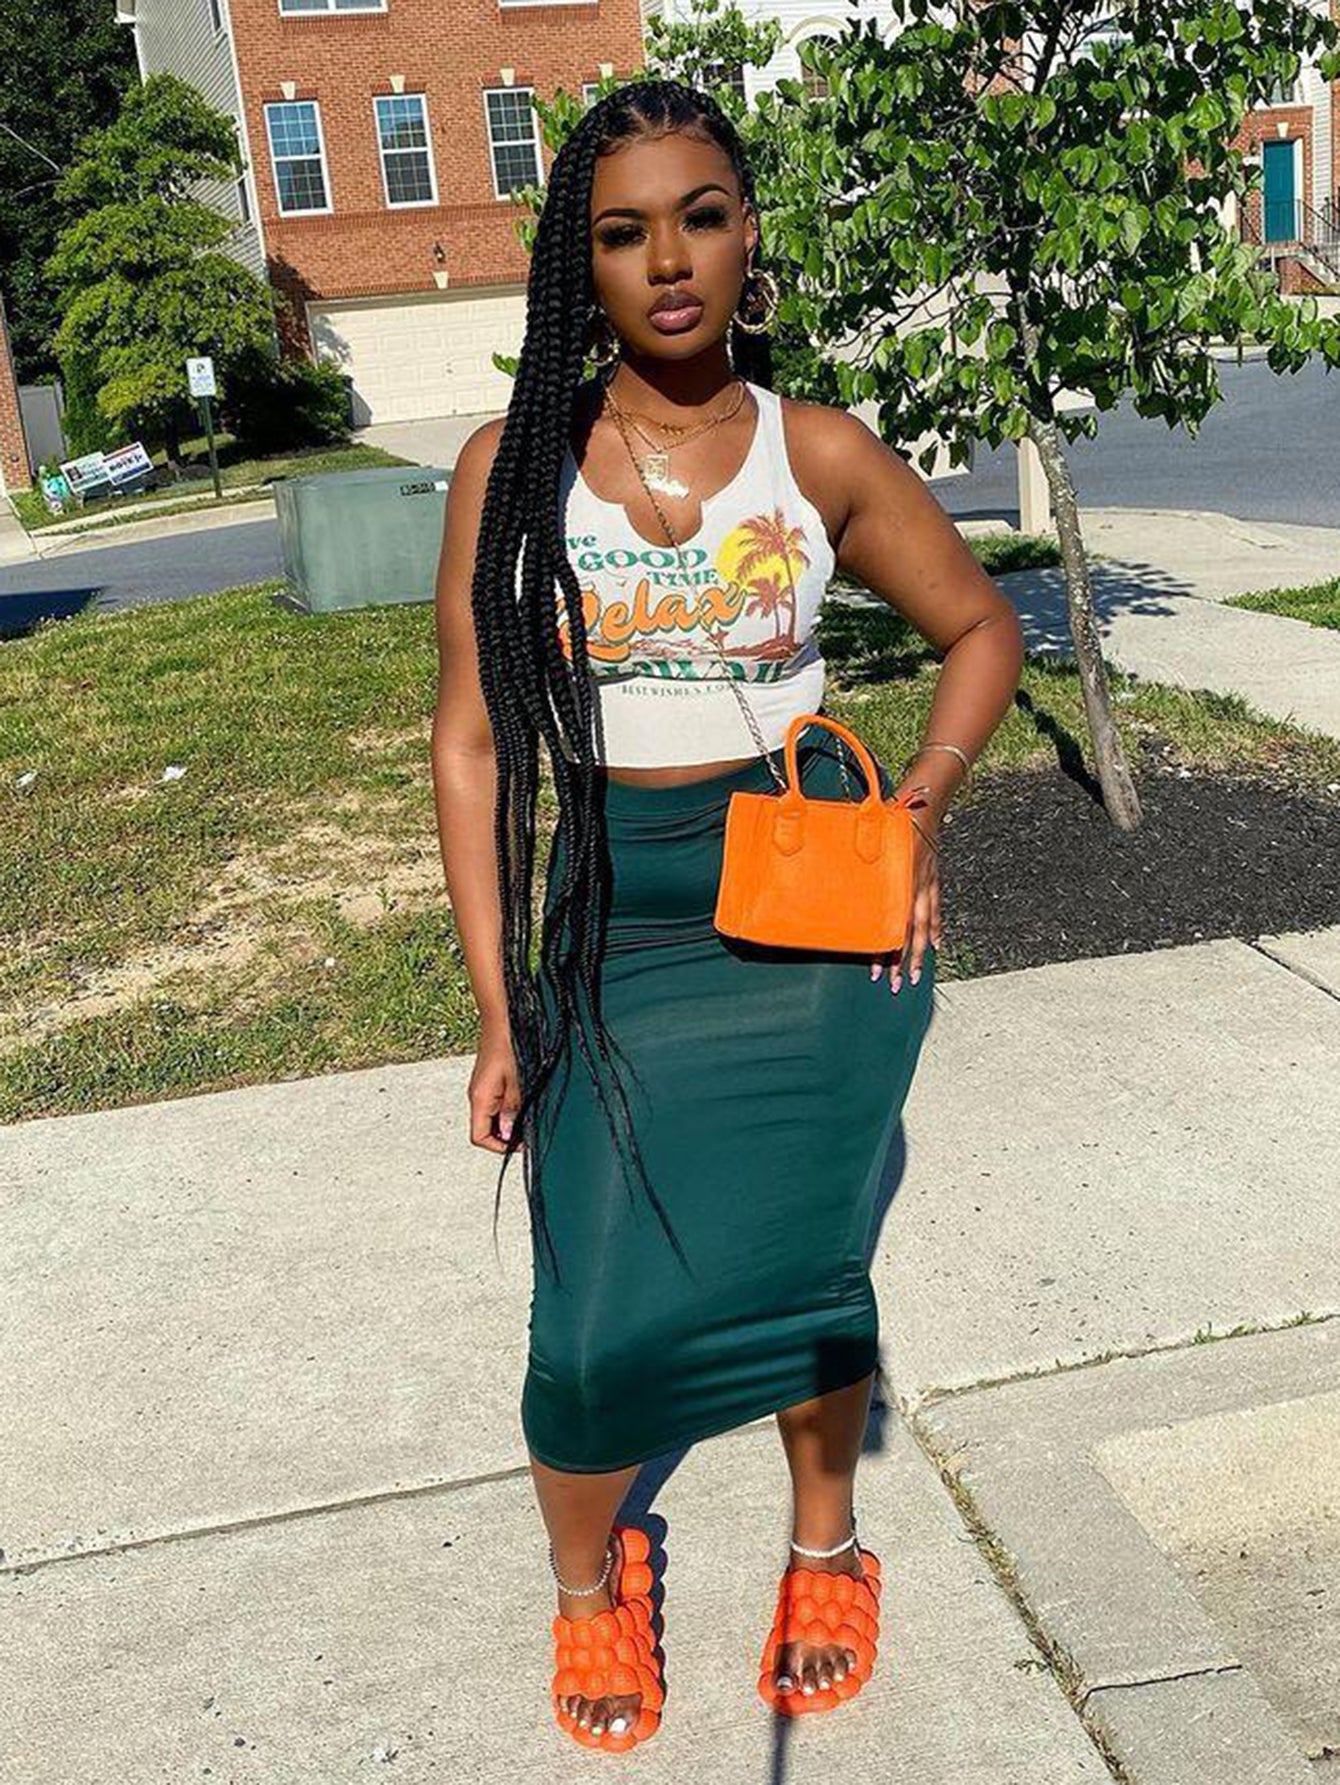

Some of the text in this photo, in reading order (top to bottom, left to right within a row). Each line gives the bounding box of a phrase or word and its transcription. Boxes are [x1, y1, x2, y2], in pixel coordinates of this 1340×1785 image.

[567, 534, 596, 550] ve
[578, 549, 708, 571] GOOD
[647, 569, 719, 586] TIME
[621, 684, 647, 695] BEST
